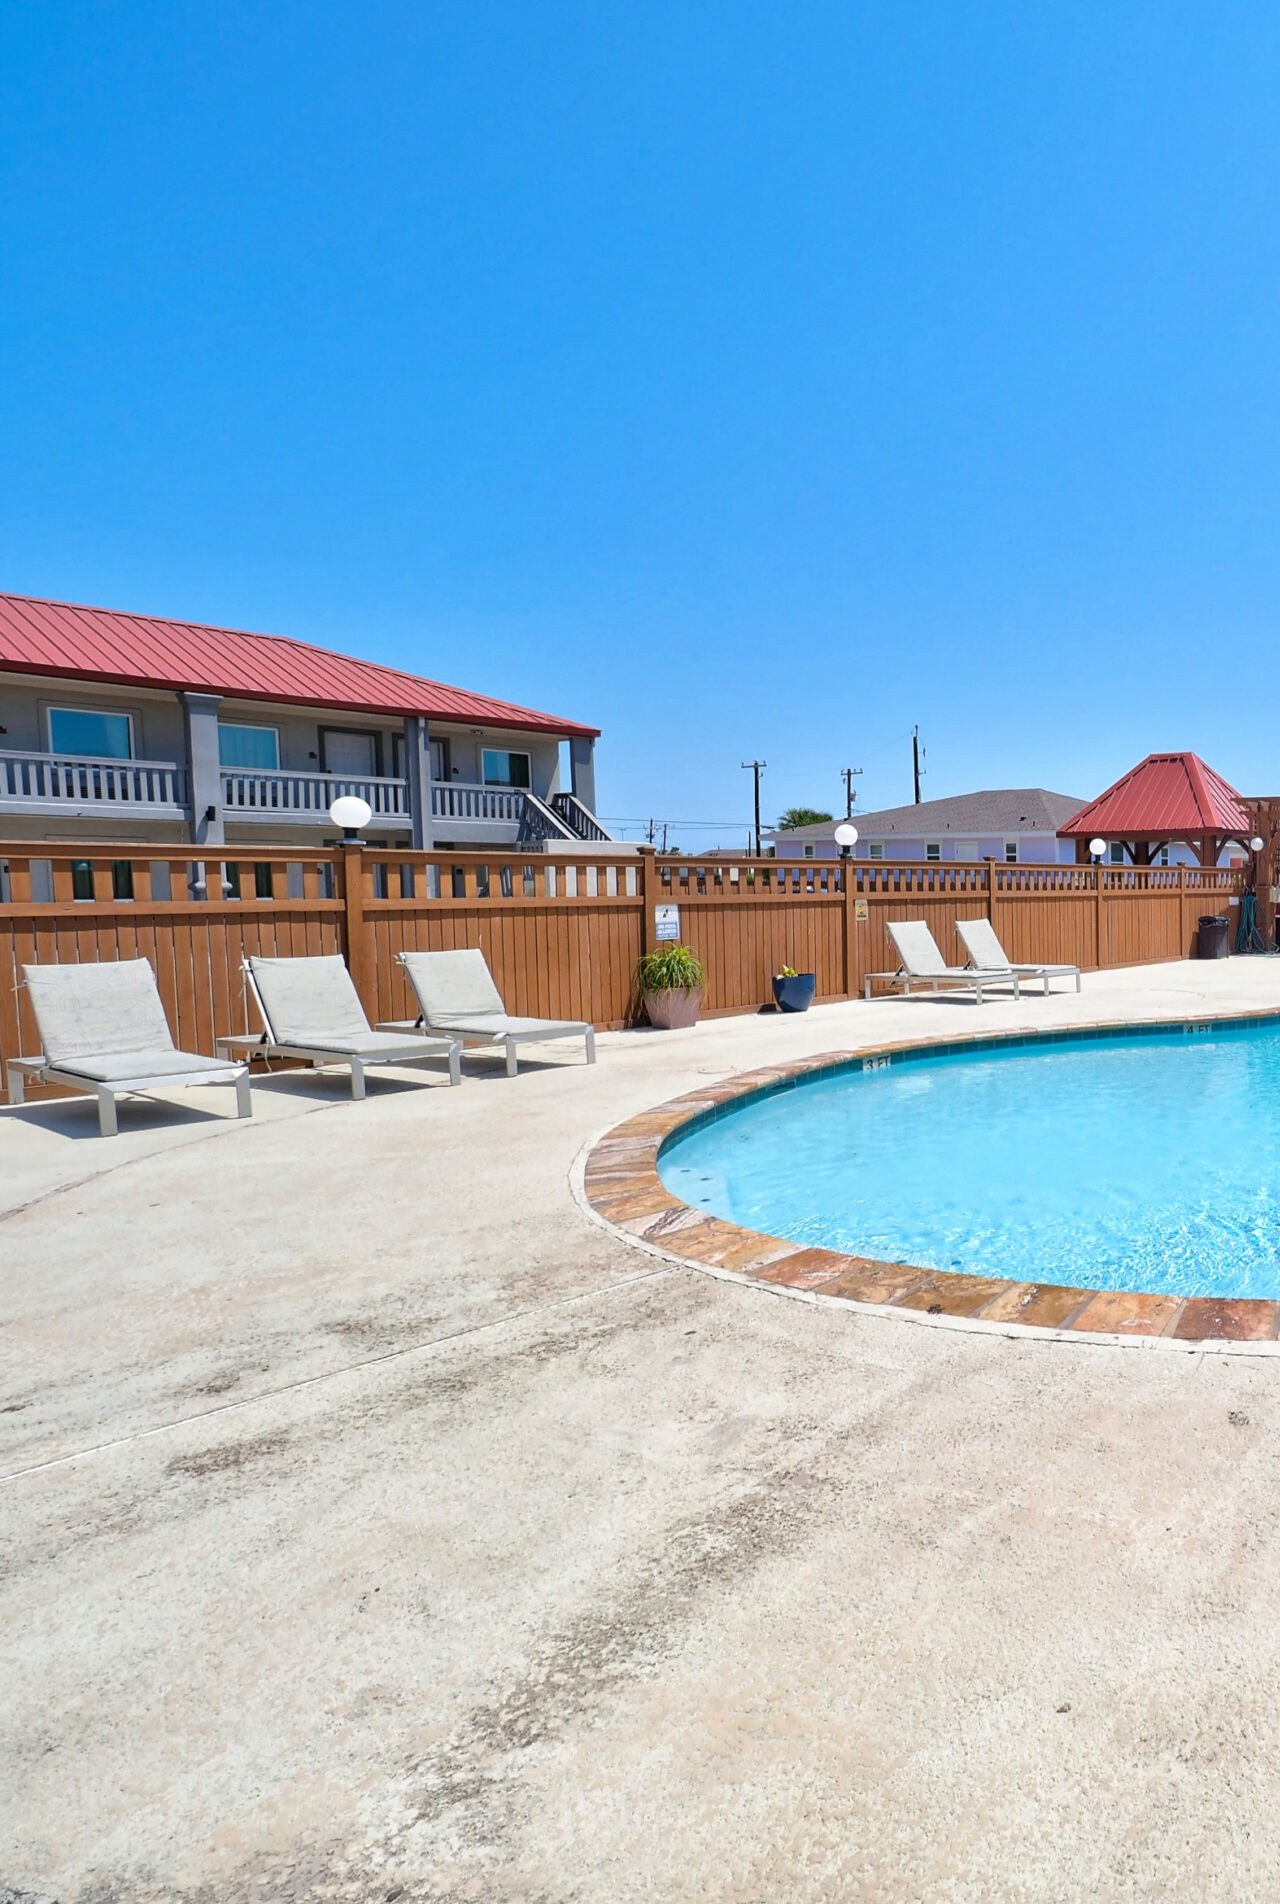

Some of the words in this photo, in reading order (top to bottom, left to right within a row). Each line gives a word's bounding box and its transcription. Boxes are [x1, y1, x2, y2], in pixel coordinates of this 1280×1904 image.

[1187, 1024, 1193, 1033] 4
[1198, 1024, 1210, 1033] FT
[866, 1058, 874, 1070] 3
[877, 1055, 890, 1068] FT
